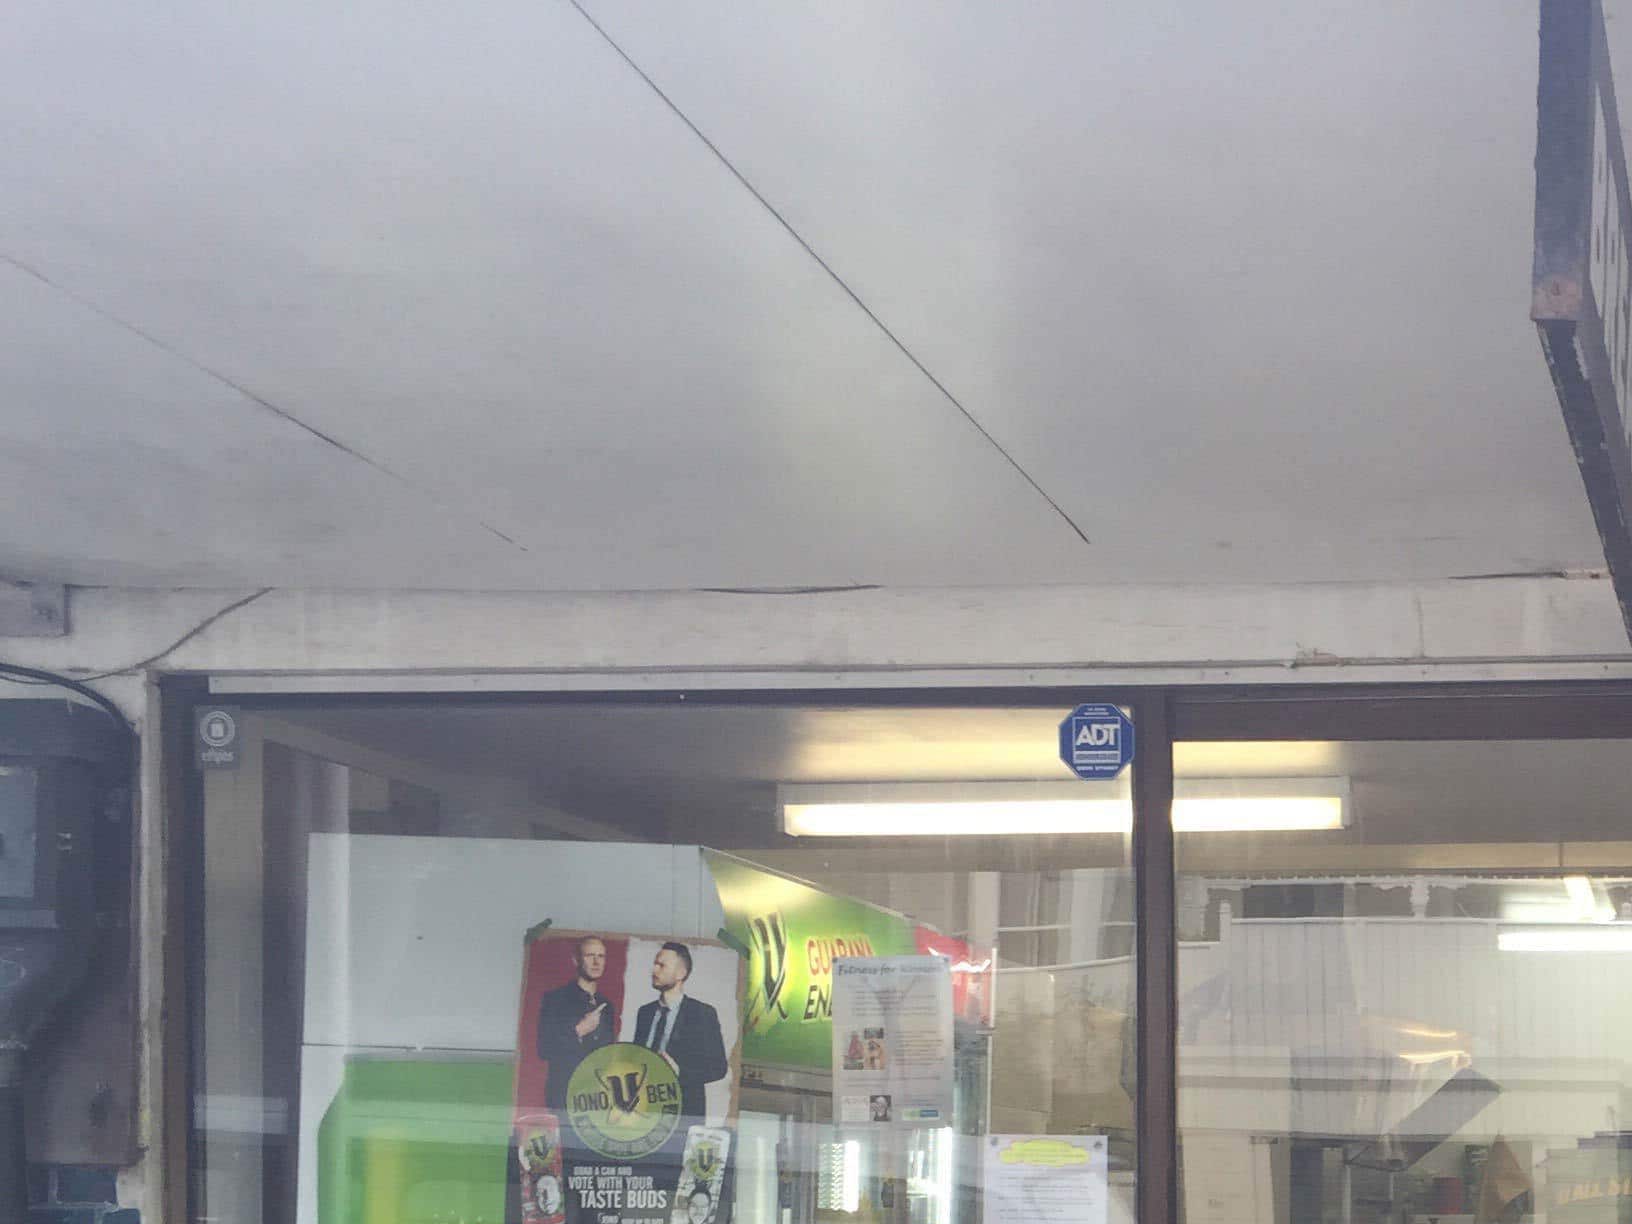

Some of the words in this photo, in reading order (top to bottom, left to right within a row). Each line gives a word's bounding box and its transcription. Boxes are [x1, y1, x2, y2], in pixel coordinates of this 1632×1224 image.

[1076, 724, 1120, 745] ADT
[646, 1082, 677, 1103] BEN
[568, 1176, 594, 1190] VOTE
[597, 1176, 623, 1190] WITH
[626, 1176, 654, 1190] YOUR
[579, 1190, 622, 1209] TASTE
[627, 1190, 668, 1209] BUDS
